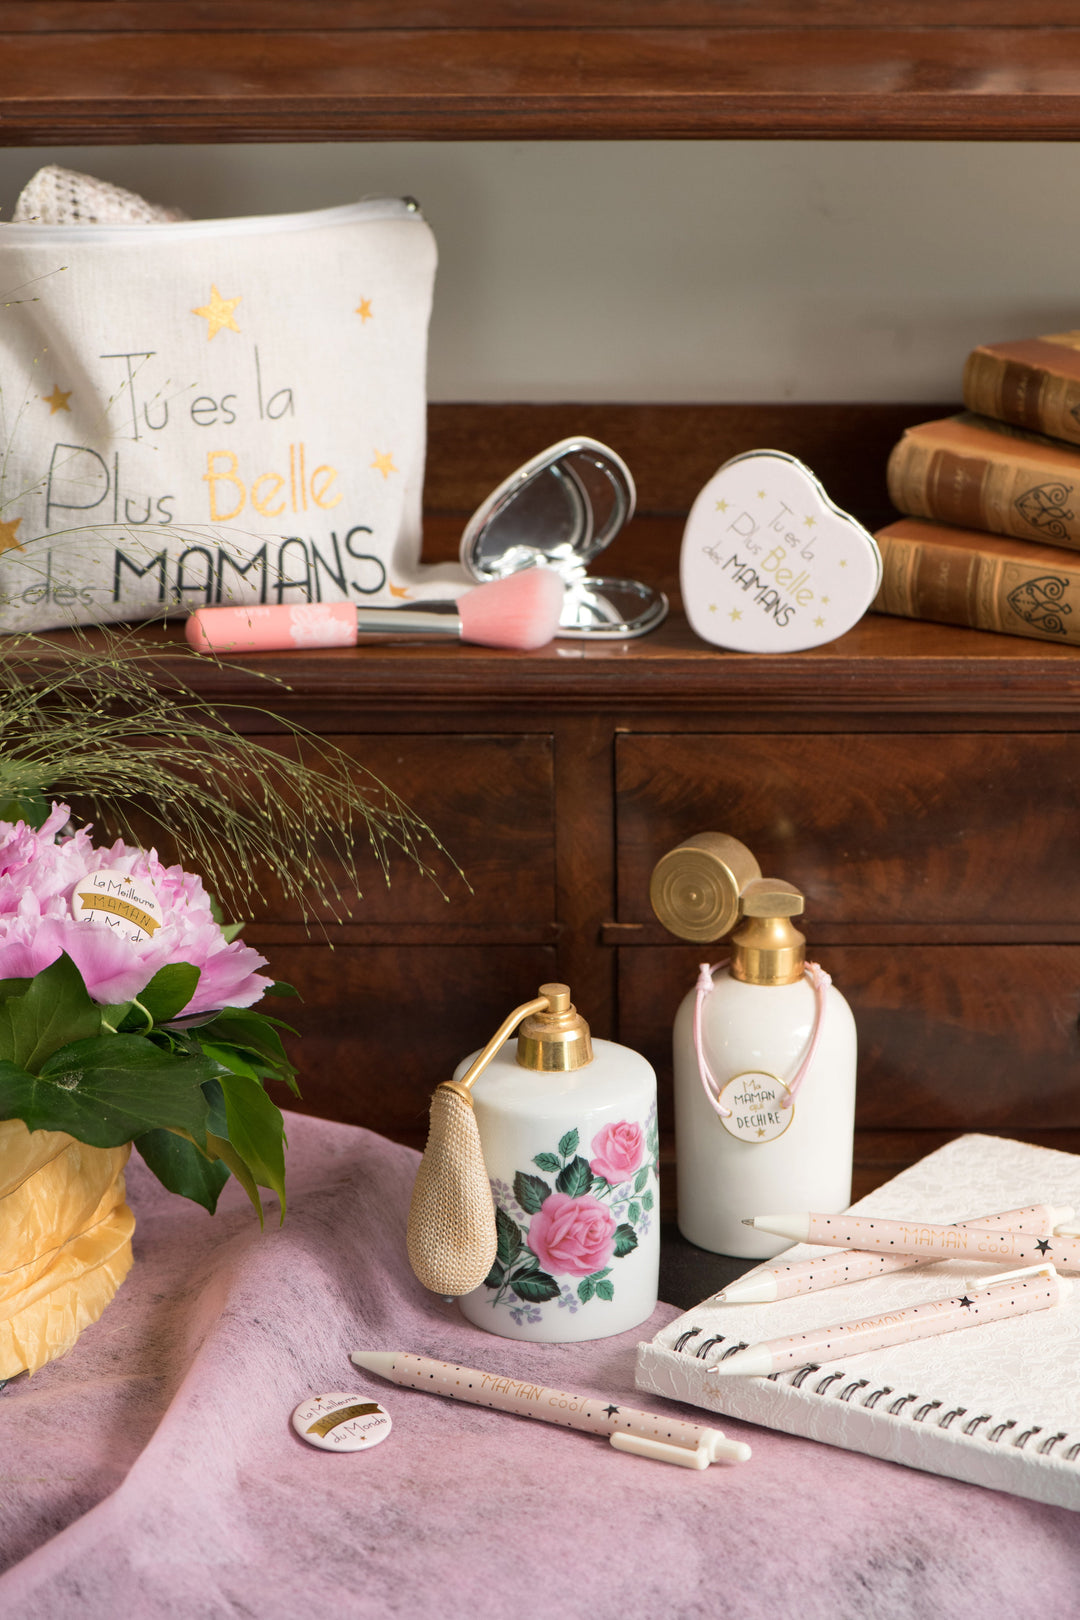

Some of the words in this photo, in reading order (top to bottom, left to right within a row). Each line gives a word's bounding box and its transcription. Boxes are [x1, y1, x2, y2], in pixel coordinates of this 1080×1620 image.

[100, 351, 169, 441] Tu
[191, 394, 237, 426] es
[254, 345, 295, 421] la
[45, 443, 174, 528] Plus
[203, 443, 344, 522] Belle
[768, 501, 794, 533] Tu
[784, 532, 801, 548] es
[22, 547, 96, 606] des
[114, 526, 387, 605] MAMANS
[760, 545, 814, 607] Belle
[721, 554, 796, 627] MAMANS
[93, 875, 106, 888] La
[107, 880, 155, 909] Meilleure
[93, 895, 151, 927] MAMAN
[734, 1090, 776, 1105] MAMAN
[743, 1079, 761, 1093] Ma
[736, 1112, 781, 1129] DECHIRE
[903, 1228, 968, 1249] MAMAN
[977, 1235, 1016, 1255] cool
[311, 1396, 358, 1415] Meilleure
[481, 1375, 545, 1401] MAMAN
[548, 1398, 588, 1413] cool
[331, 1431, 347, 1443] du
[344, 1415, 388, 1437] Monde
